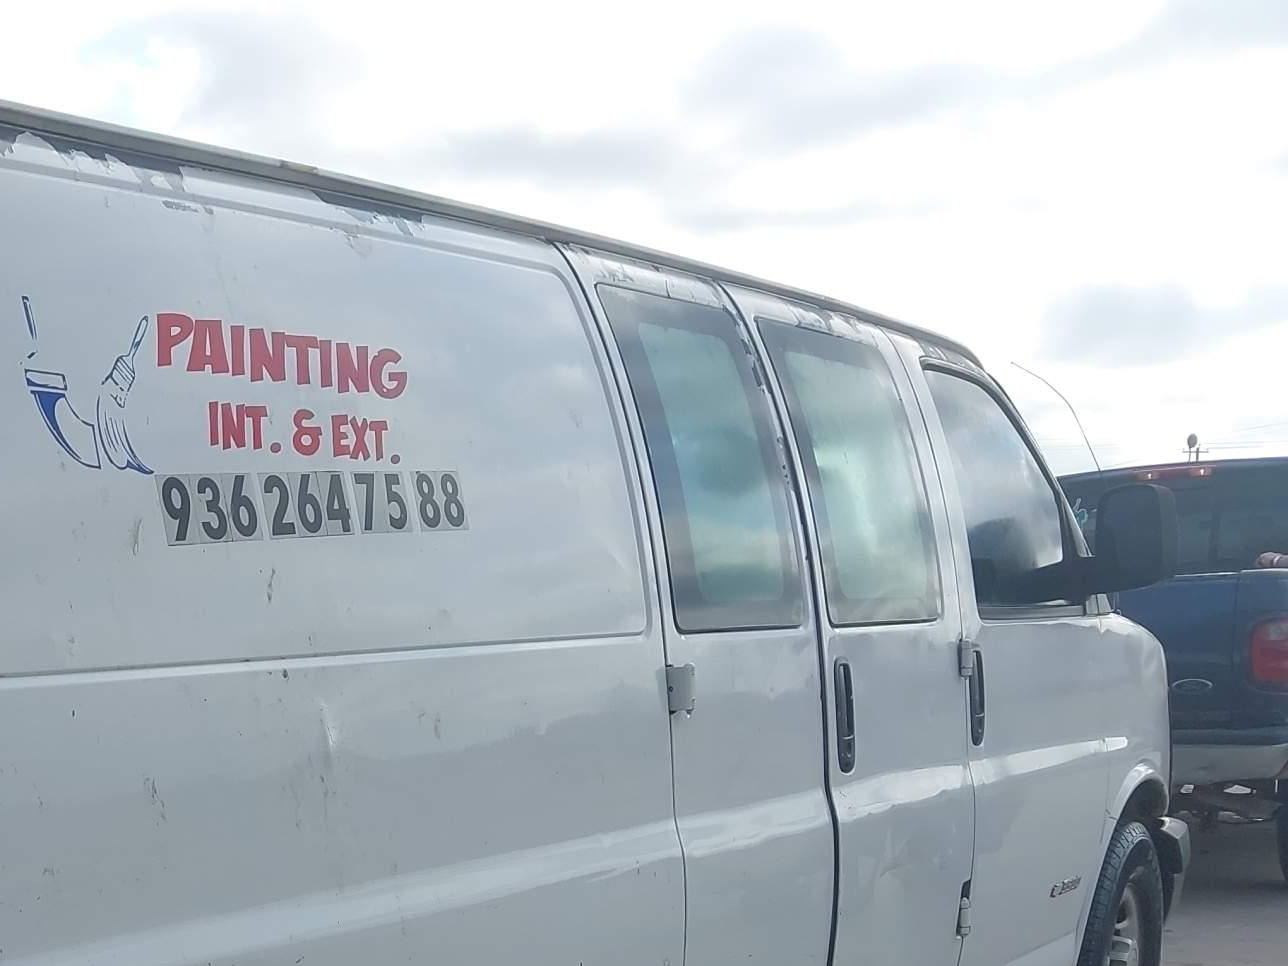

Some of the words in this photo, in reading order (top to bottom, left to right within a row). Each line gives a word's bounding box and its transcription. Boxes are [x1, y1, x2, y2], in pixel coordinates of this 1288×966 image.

[156, 312, 408, 400] PAINTING
[208, 400, 282, 454] INT.
[292, 408, 323, 456] &
[330, 413, 401, 464] EXT.
